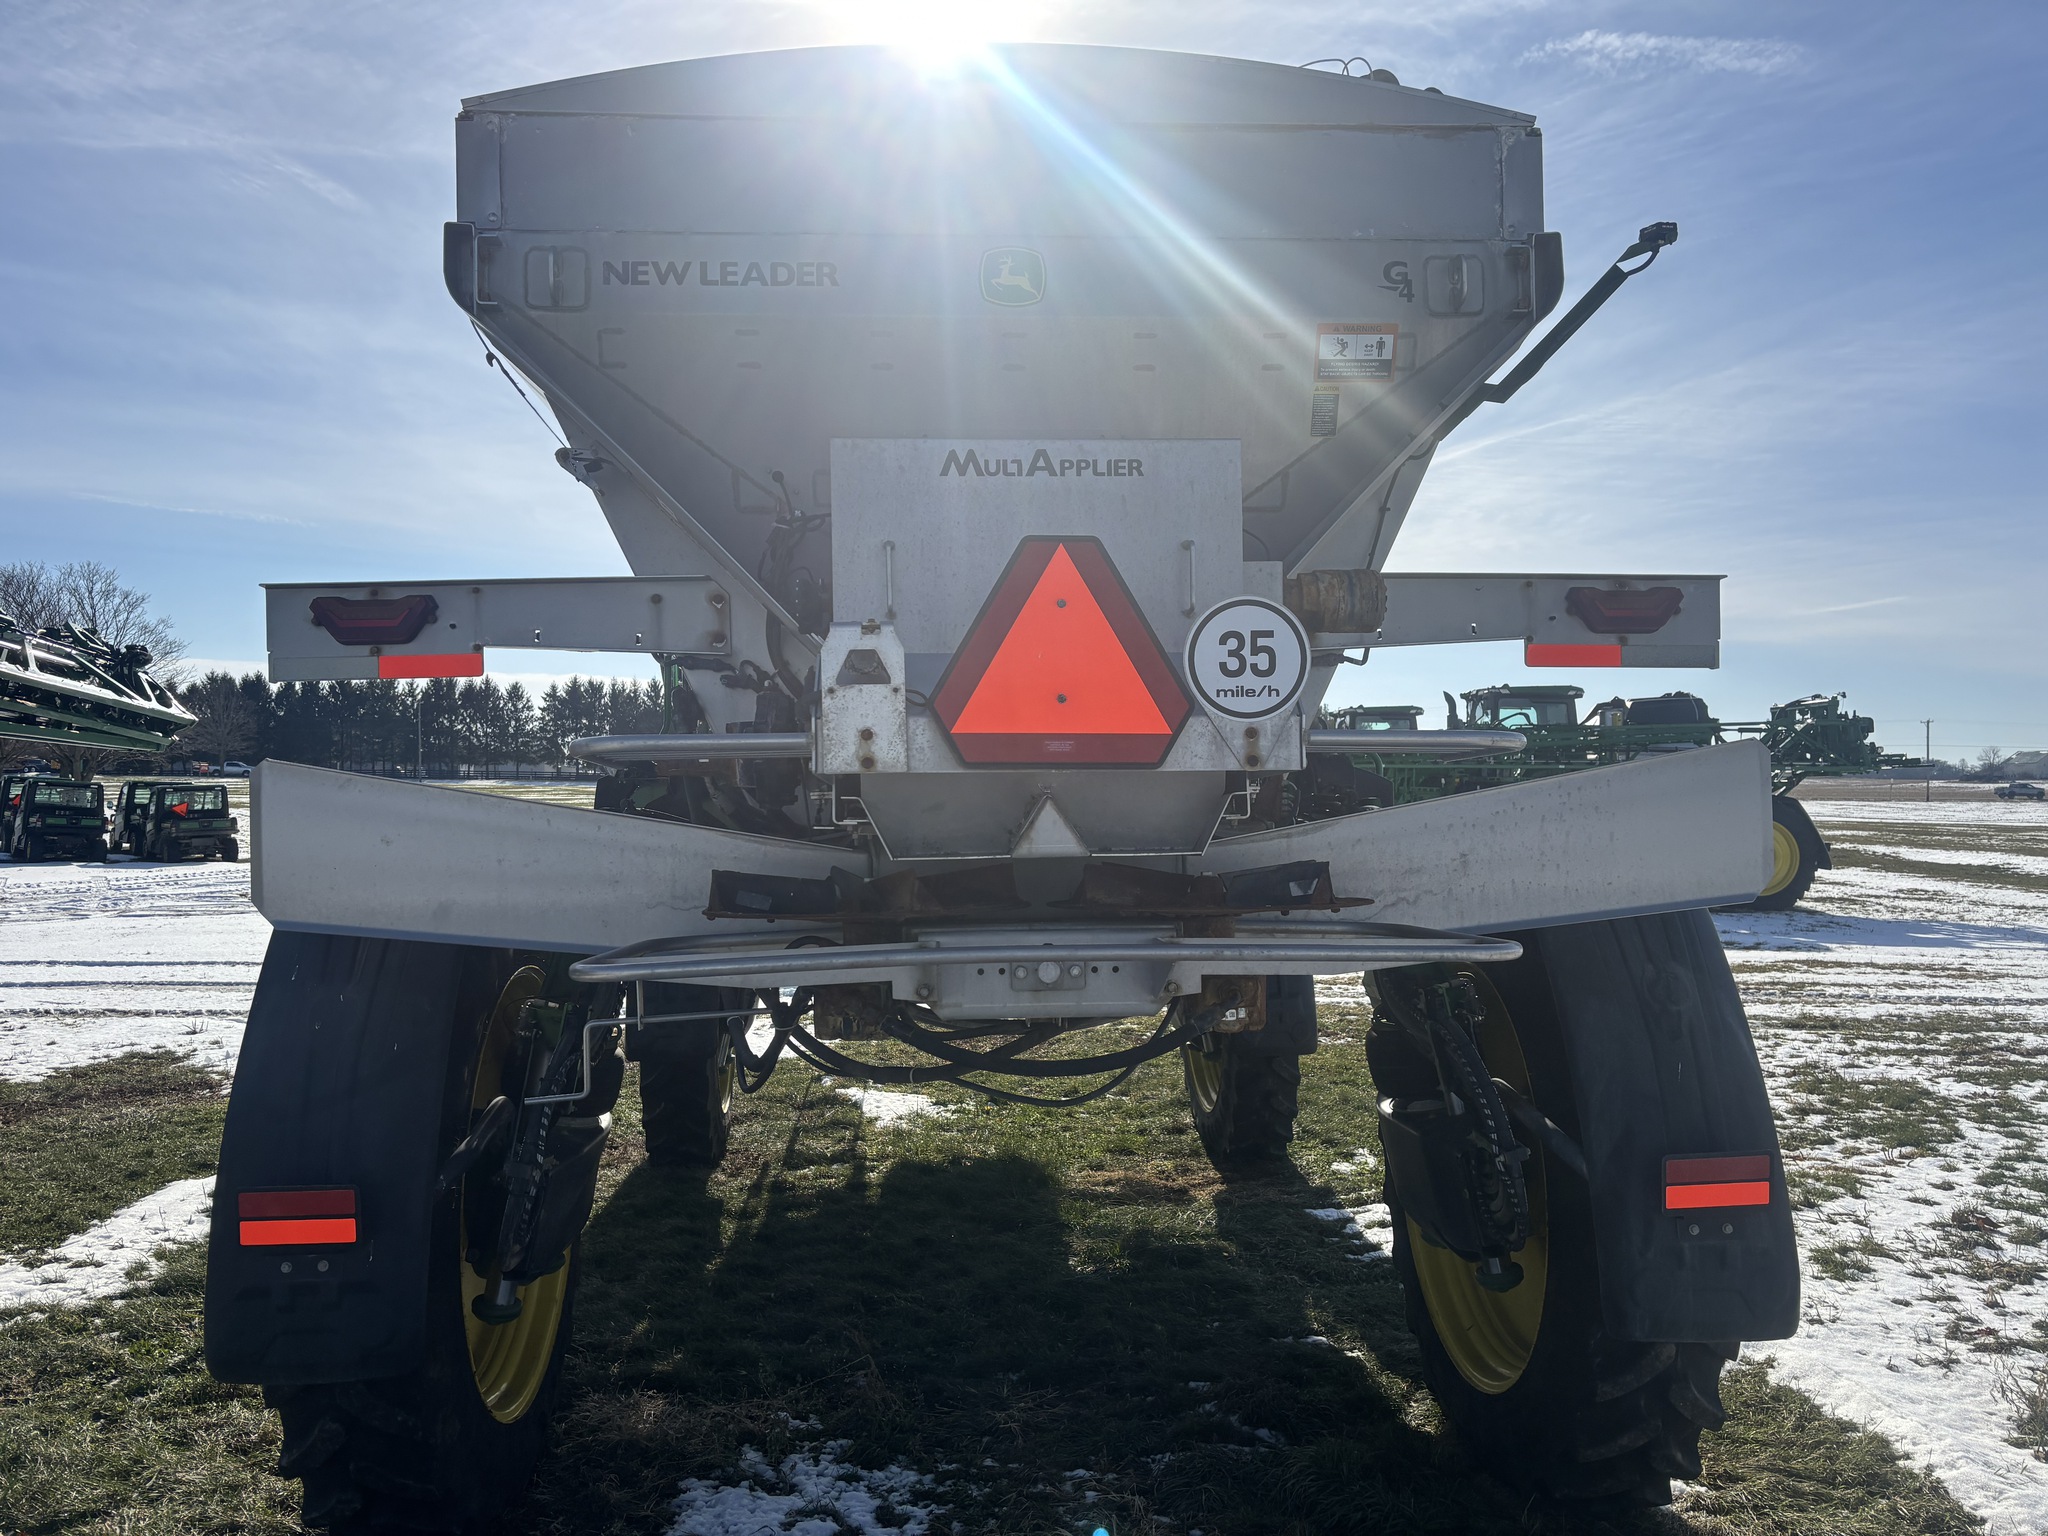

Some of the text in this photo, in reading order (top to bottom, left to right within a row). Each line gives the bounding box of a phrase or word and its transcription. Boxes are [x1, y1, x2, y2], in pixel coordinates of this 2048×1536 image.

[602, 261, 840, 287] NEW LEADER
[1382, 260, 1416, 303] G4
[1343, 325, 1382, 333] WARNING
[1218, 630, 1277, 679] 35
[1215, 685, 1281, 698] mile/h
